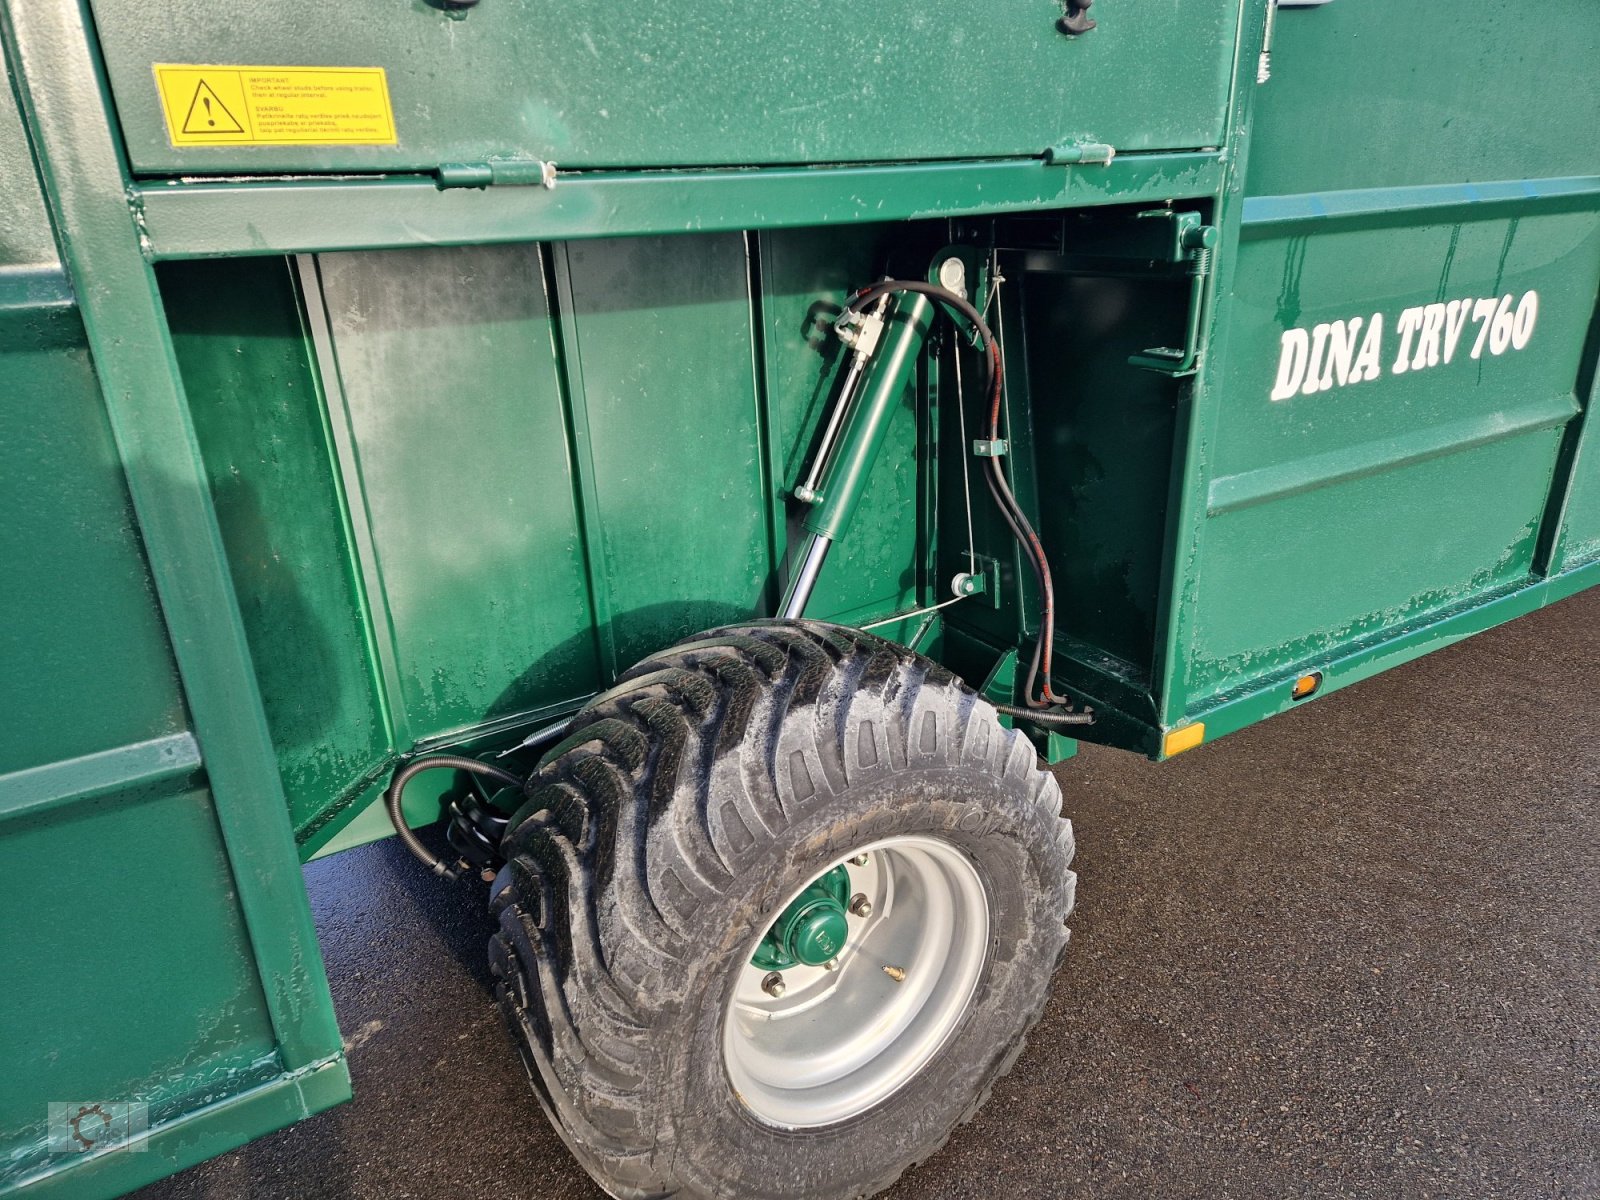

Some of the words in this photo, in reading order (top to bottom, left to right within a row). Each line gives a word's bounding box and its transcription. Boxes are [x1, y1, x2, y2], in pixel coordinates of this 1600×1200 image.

[1270, 312, 1384, 401] DINA
[1391, 298, 1473, 374] TRV
[1470, 290, 1539, 360] 760
